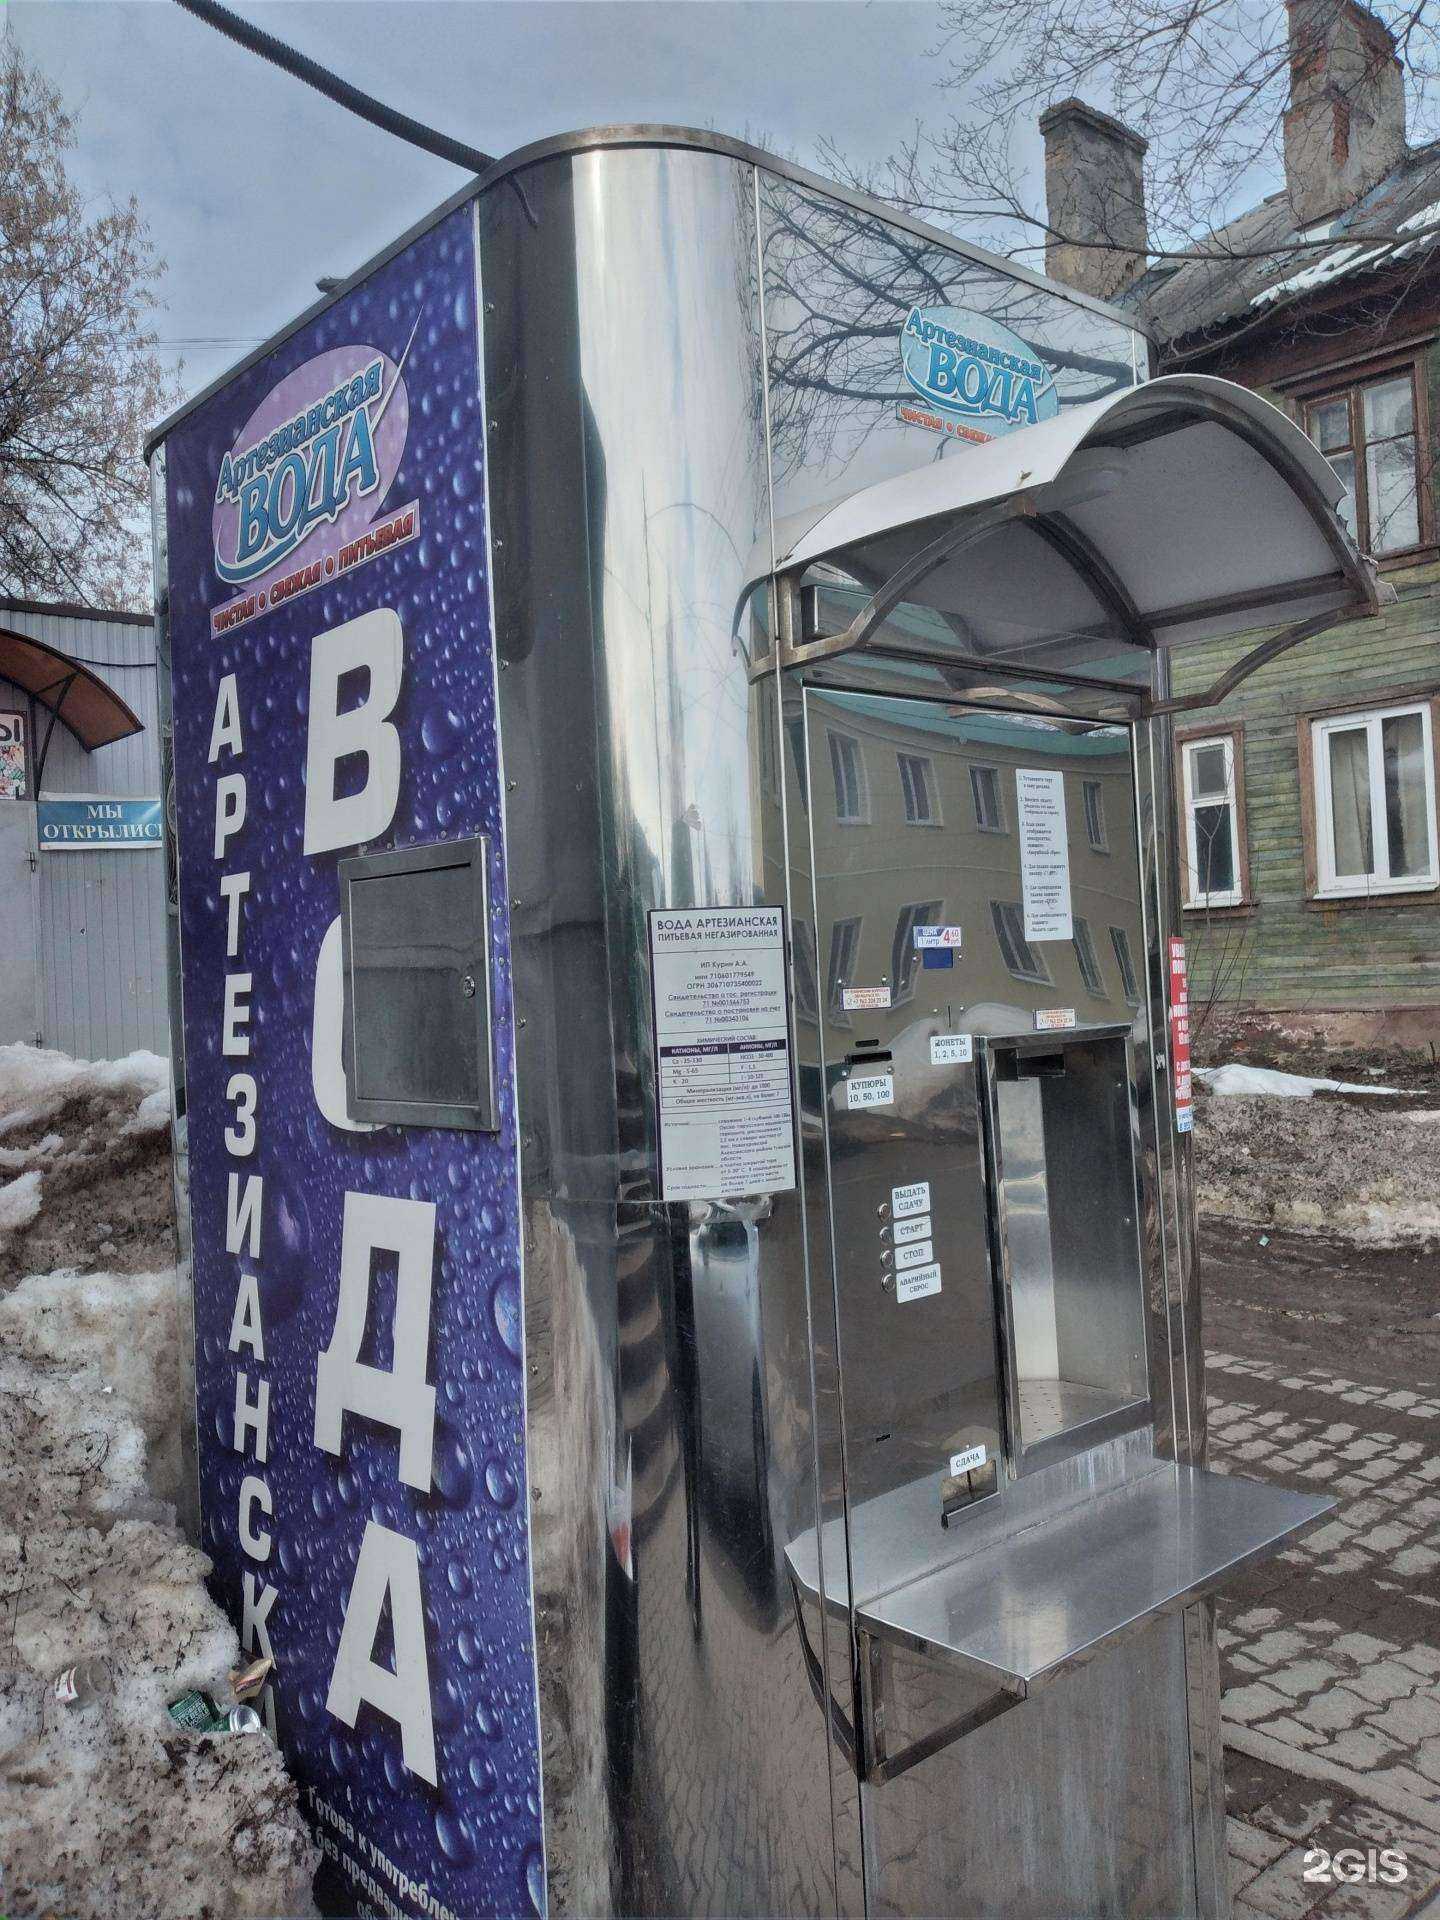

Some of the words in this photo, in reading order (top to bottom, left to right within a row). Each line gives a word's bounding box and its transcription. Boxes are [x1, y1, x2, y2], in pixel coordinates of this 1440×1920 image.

[905, 307, 1042, 381] Артезианская
[927, 343, 1038, 423] ВОДА
[900, 407, 943, 430] ЧИСТАЯ
[217, 360, 383, 500] Артезианская
[236, 408, 377, 561] ВОДА
[213, 594, 255, 632] ЧИСТАЯ
[269, 561, 321, 606] СВЕЖАЯ
[338, 512, 415, 571] ПИТЬЕВАЯ
[87, 805, 123, 819] МЫ
[657, 919, 692, 930] ВОДА
[696, 916, 778, 929] АРТЕЗИАНСКАЯ
[658, 932, 702, 942] ПИТЬЕВАЯ
[704, 929, 778, 940] НЕГАЗИРОВАННАЯ
[935, 1037, 966, 1047] МОНЕТЫ
[851, 1079, 888, 1091] КУПЮРЫ
[877, 1091, 890, 1099] 100
[894, 1187, 926, 1200] ВЫДАТЬ
[898, 1199, 924, 1211] СДАЧУ
[900, 1223, 924, 1236] СТАРТ
[903, 1248, 924, 1260] СТОП
[899, 1270, 937, 1287] АВАРИЙНЫЙ
[909, 1282, 929, 1293] СБРОС
[955, 1452, 980, 1468] СДАЧА
[308, 1785, 355, 1843] Готова
[358, 1832, 367, 1854] к
